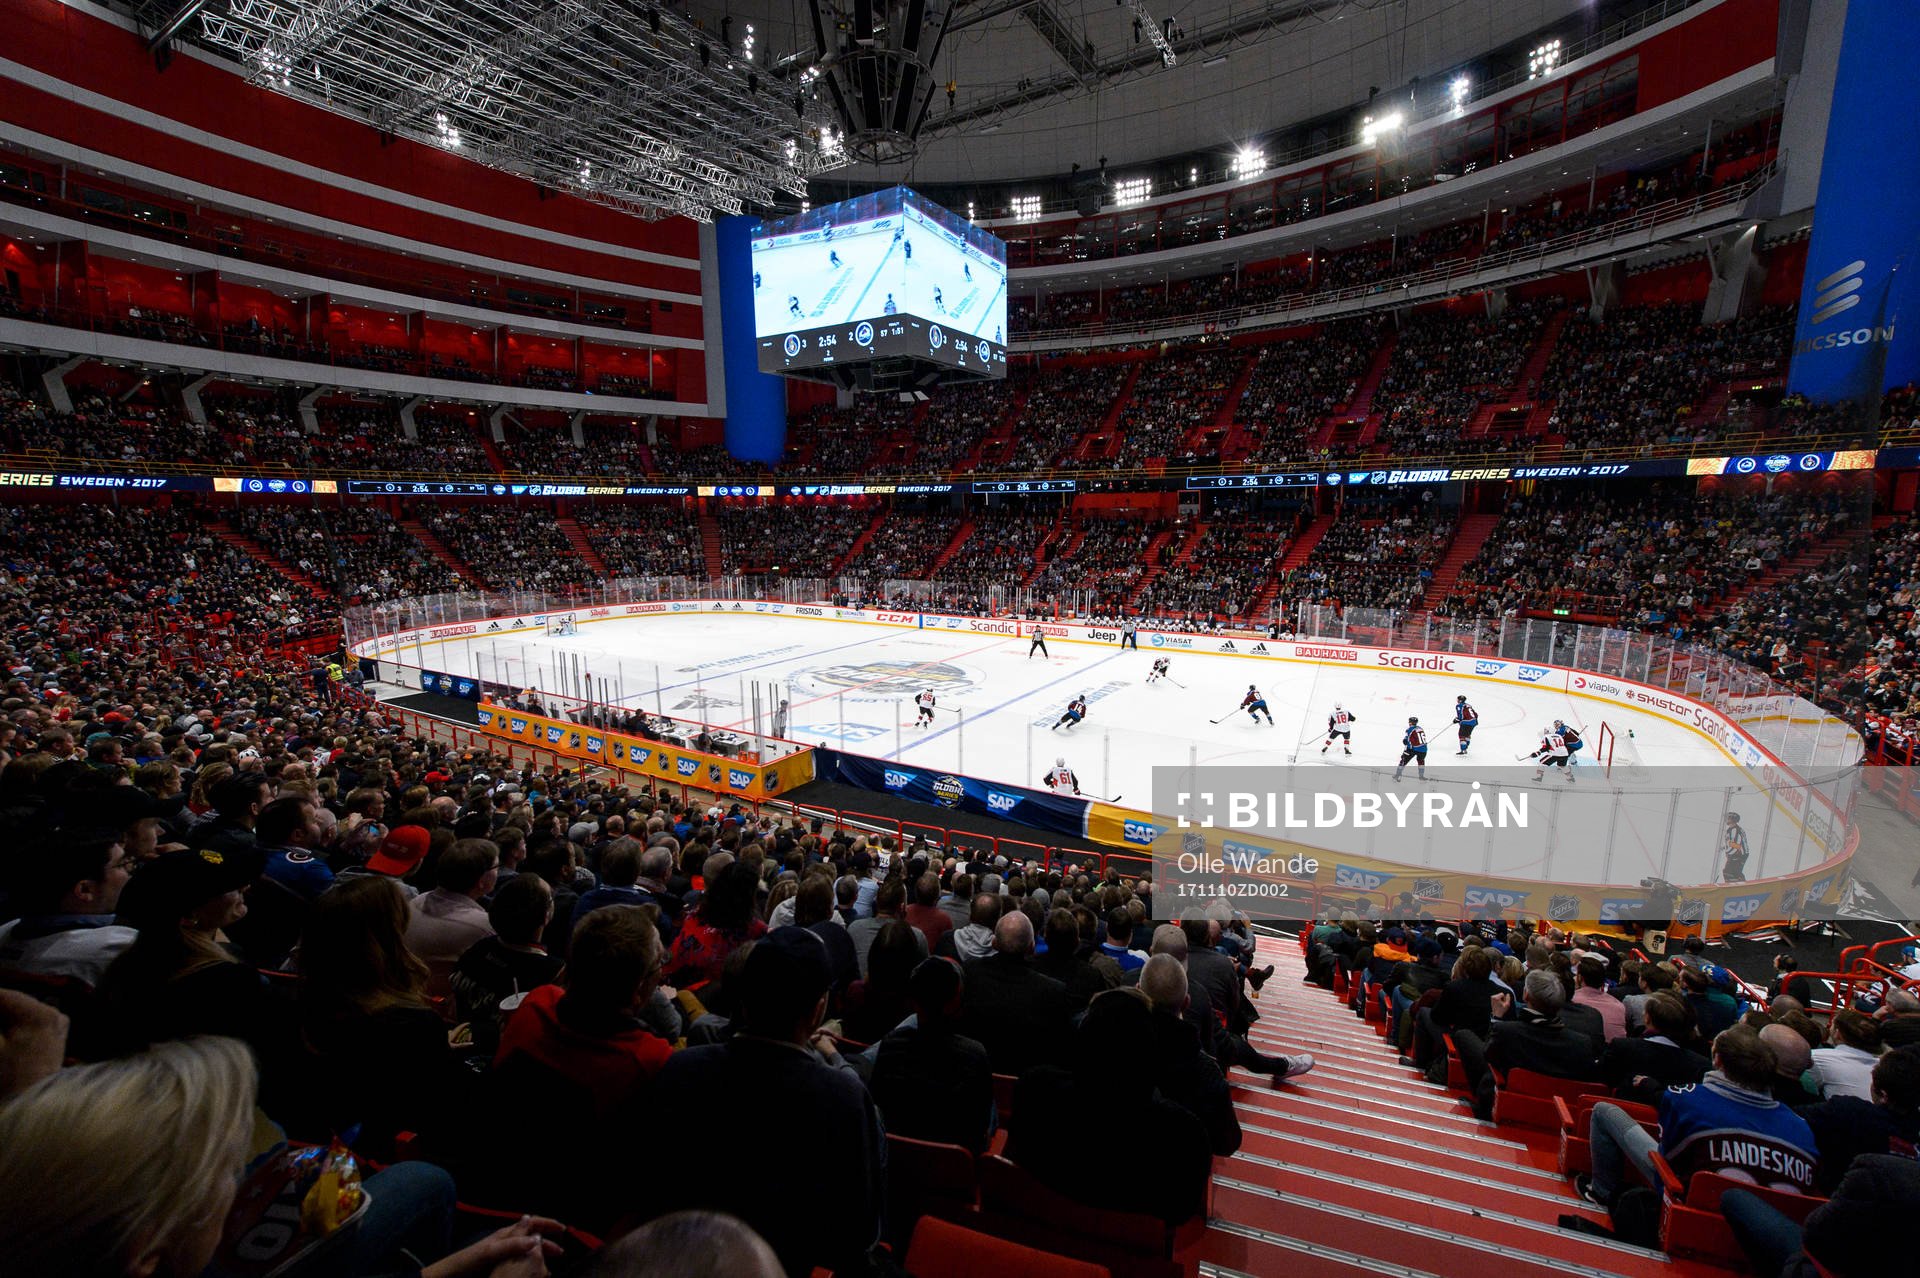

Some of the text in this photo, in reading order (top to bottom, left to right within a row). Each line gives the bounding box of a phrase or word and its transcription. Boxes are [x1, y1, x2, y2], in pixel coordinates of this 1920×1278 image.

[801, 331, 854, 348] 3 2:54 2
[60, 476, 126, 487] SWEDEN
[131, 479, 167, 487] 2017
[1242, 478, 1258, 486] 2:54
[1387, 469, 1450, 484] GLOBAL
[1450, 468, 1511, 481] SERIES
[1514, 466, 1582, 478] SWEDEN
[1588, 465, 1630, 475] 2017
[412, 485, 429, 493] 2:54
[542, 484, 587, 496] GLOBAL
[586, 486, 625, 495] SERIES
[864, 486, 896, 494] SERIES
[626, 604, 667, 613] BAUHAUS
[795, 606, 823, 616] FRISTADS
[876, 613, 914, 624] CCM
[430, 625, 477, 639] BAUHAUS
[969, 619, 1015, 635] Scandic
[1026, 625, 1068, 637] BAHAUS
[1087, 628, 1117, 642] Jeep
[1165, 637, 1193, 645] VIASAT
[1295, 646, 1358, 661] BAUHAUS
[1377, 651, 1456, 672] Scandic
[1475, 661, 1501, 675] SAP
[1518, 666, 1543, 681] SAP
[1588, 681, 1621, 696] viaplay
[479, 712, 601, 751] SAP SAP SAP SAP
[1692, 707, 1730, 748] Scandic
[630, 749, 750, 787] SAP SAP SAP
[885, 771, 909, 788] SAP
[1059, 772, 1071, 785] 61
[987, 792, 1015, 811] SAP
[1123, 822, 1158, 843] SAP
[1223, 844, 1261, 865] SAP
[1336, 868, 1382, 890] SAP
[1810, 881, 1830, 900] SAP
[1465, 890, 1514, 908] SAP
[1723, 901, 1760, 919] SAP
[1708, 1139, 1813, 1186] LANDESKOG
